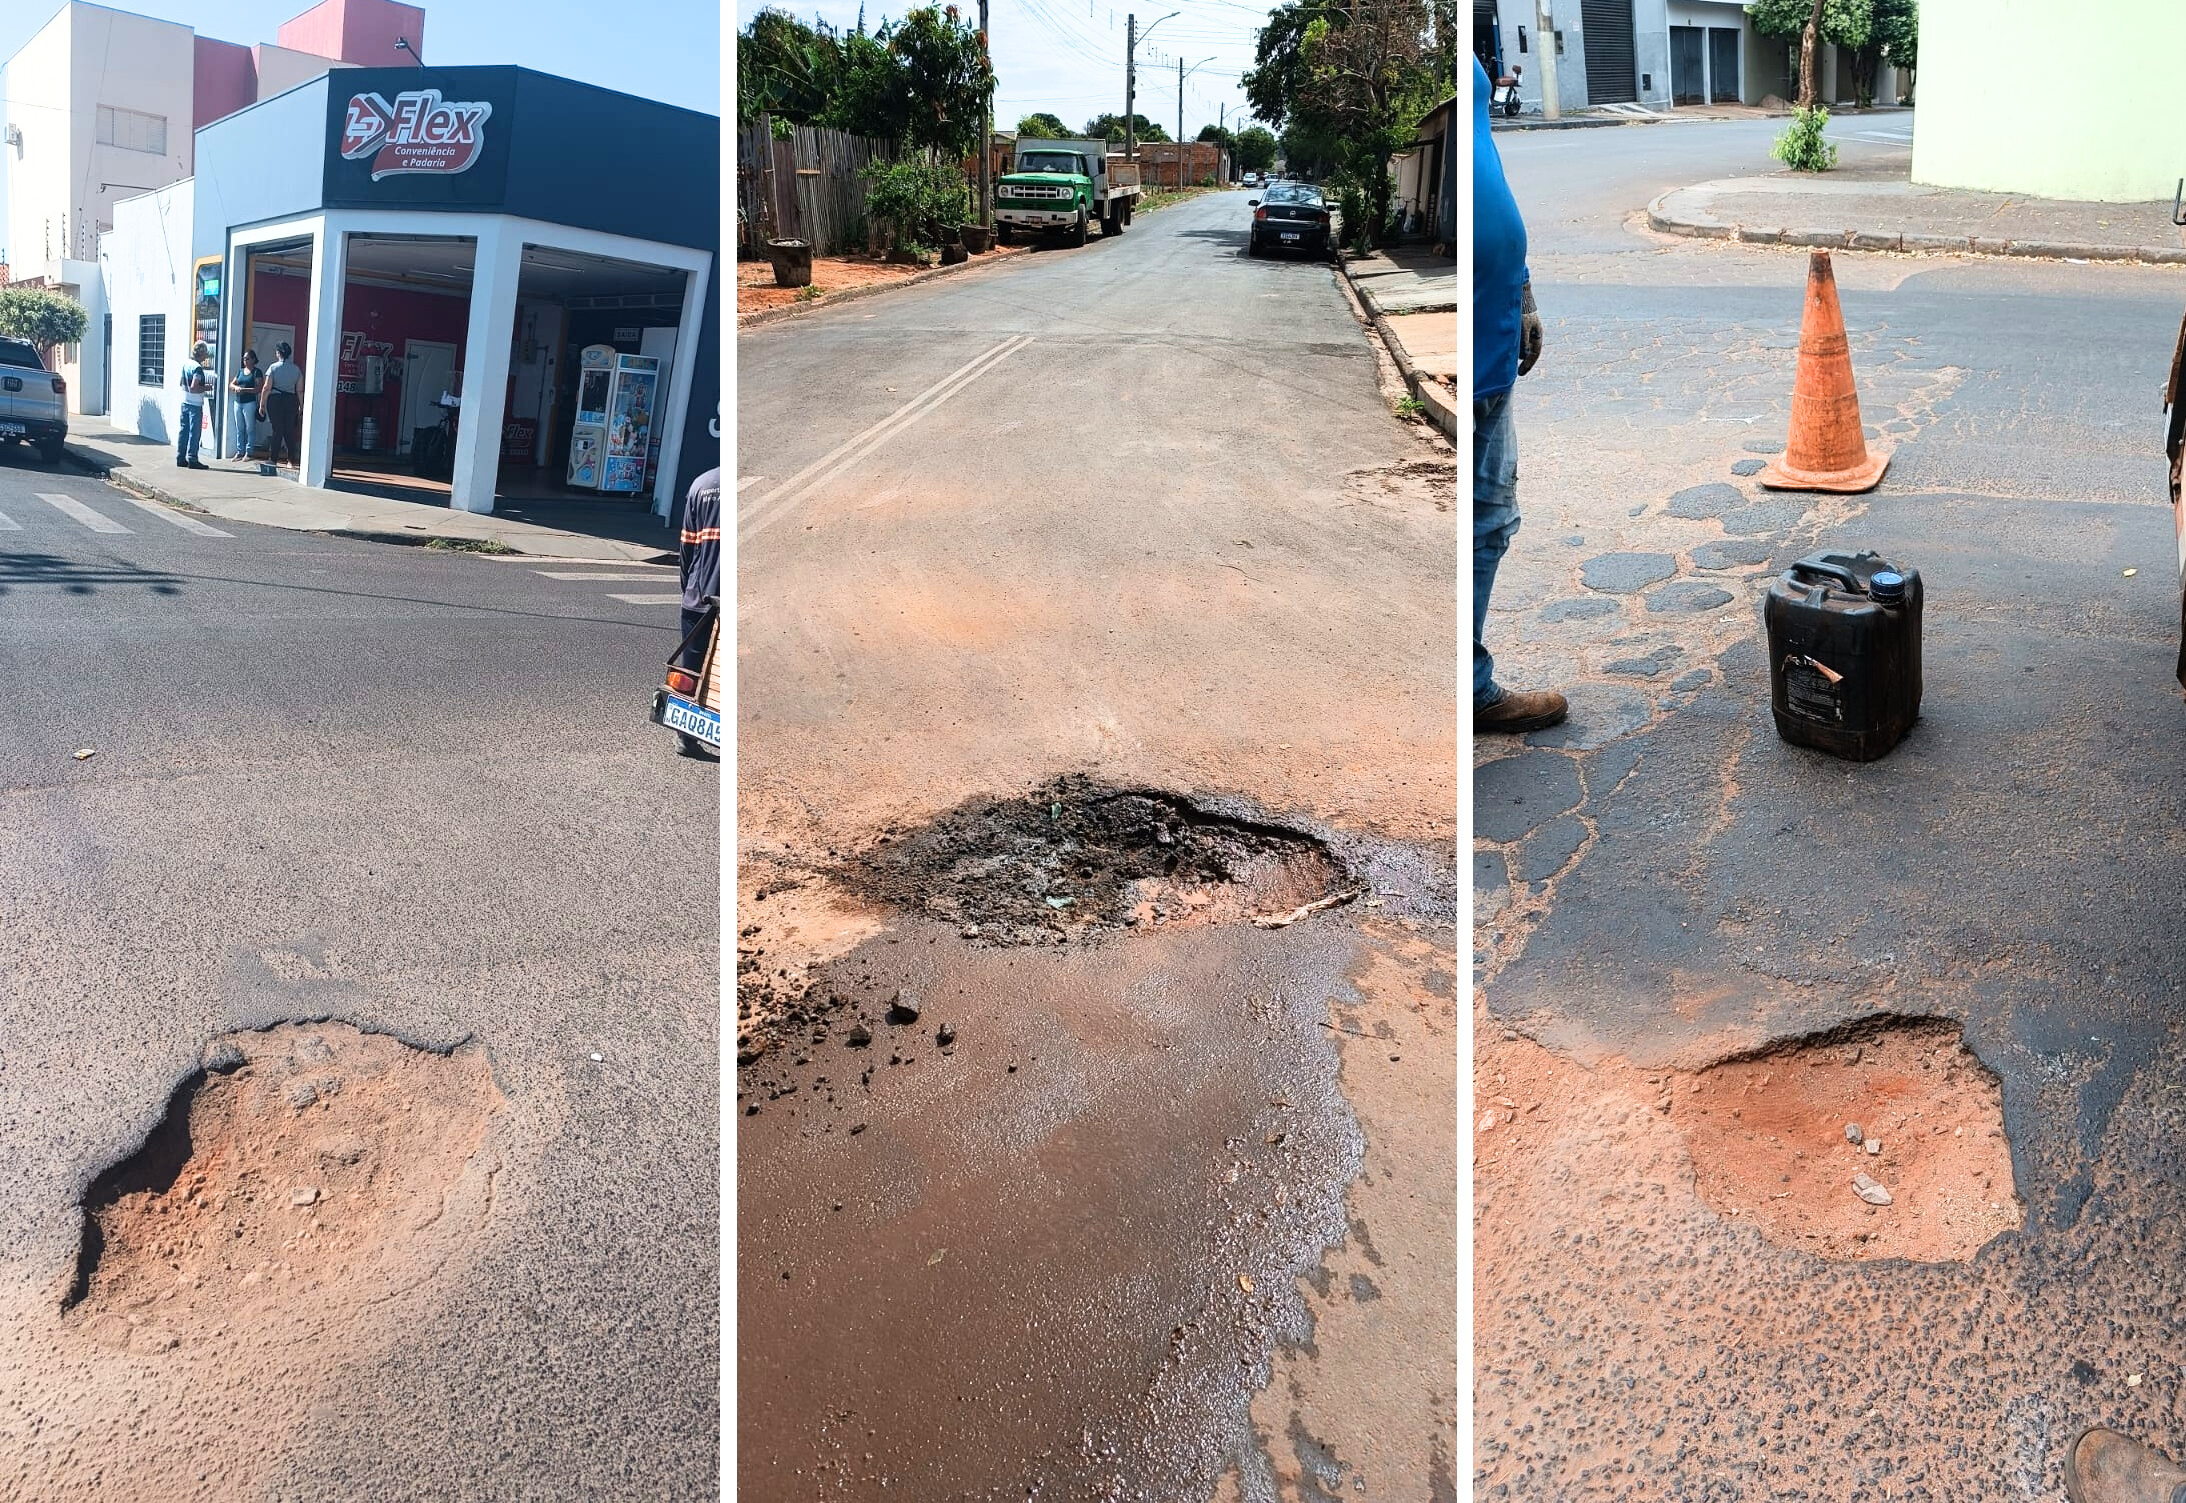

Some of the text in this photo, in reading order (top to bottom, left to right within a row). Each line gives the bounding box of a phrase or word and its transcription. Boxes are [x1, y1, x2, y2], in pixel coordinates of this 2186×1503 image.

[386, 95, 482, 144] Flex
[394, 146, 456, 156] Conveniência
[410, 158, 446, 167] Padaria
